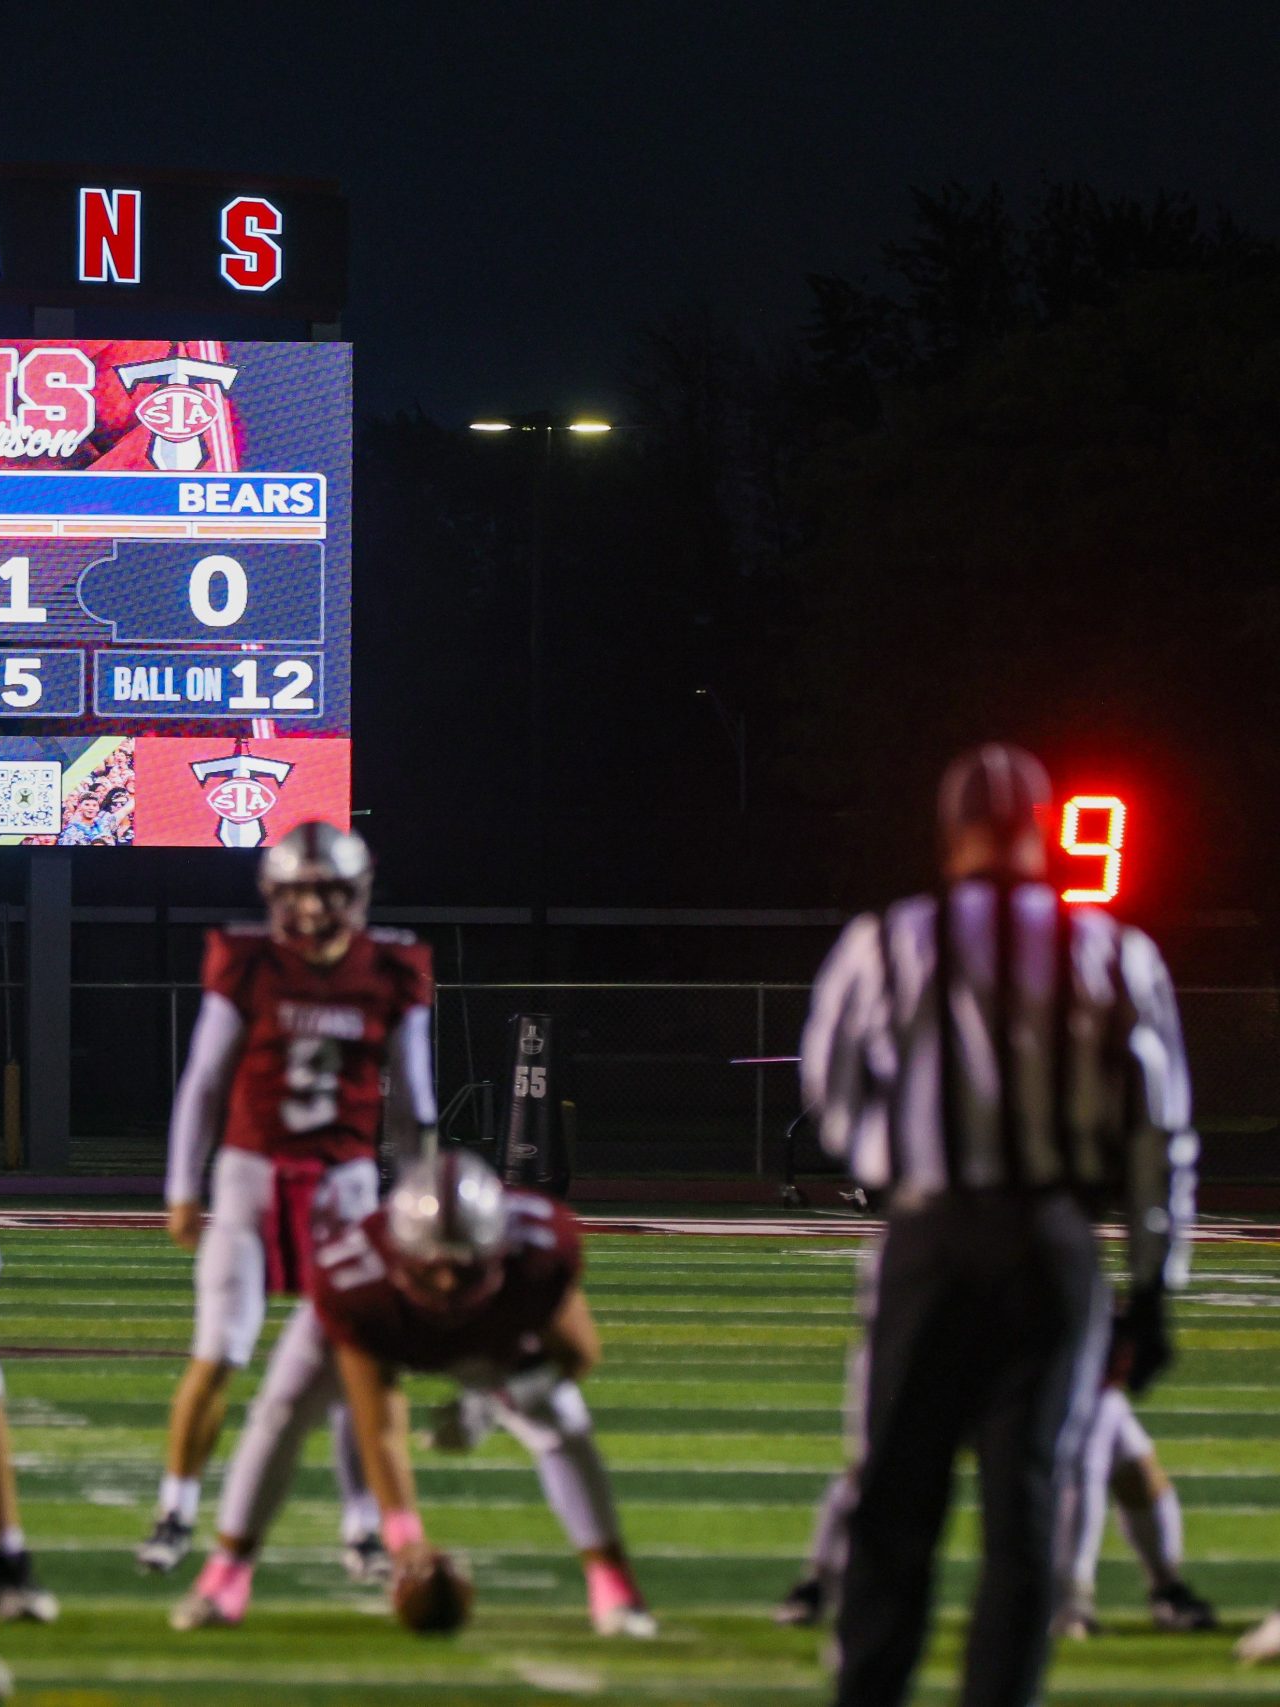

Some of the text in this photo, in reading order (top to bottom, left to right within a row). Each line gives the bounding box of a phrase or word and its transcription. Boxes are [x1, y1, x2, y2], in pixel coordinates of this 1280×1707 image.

[178, 482, 314, 515] BEARS
[189, 555, 248, 627] 0
[1, 658, 42, 708] 5
[114, 659, 314, 710] BALL ON 12
[1060, 795, 1127, 902] 9
[514, 1066, 547, 1098] 55
